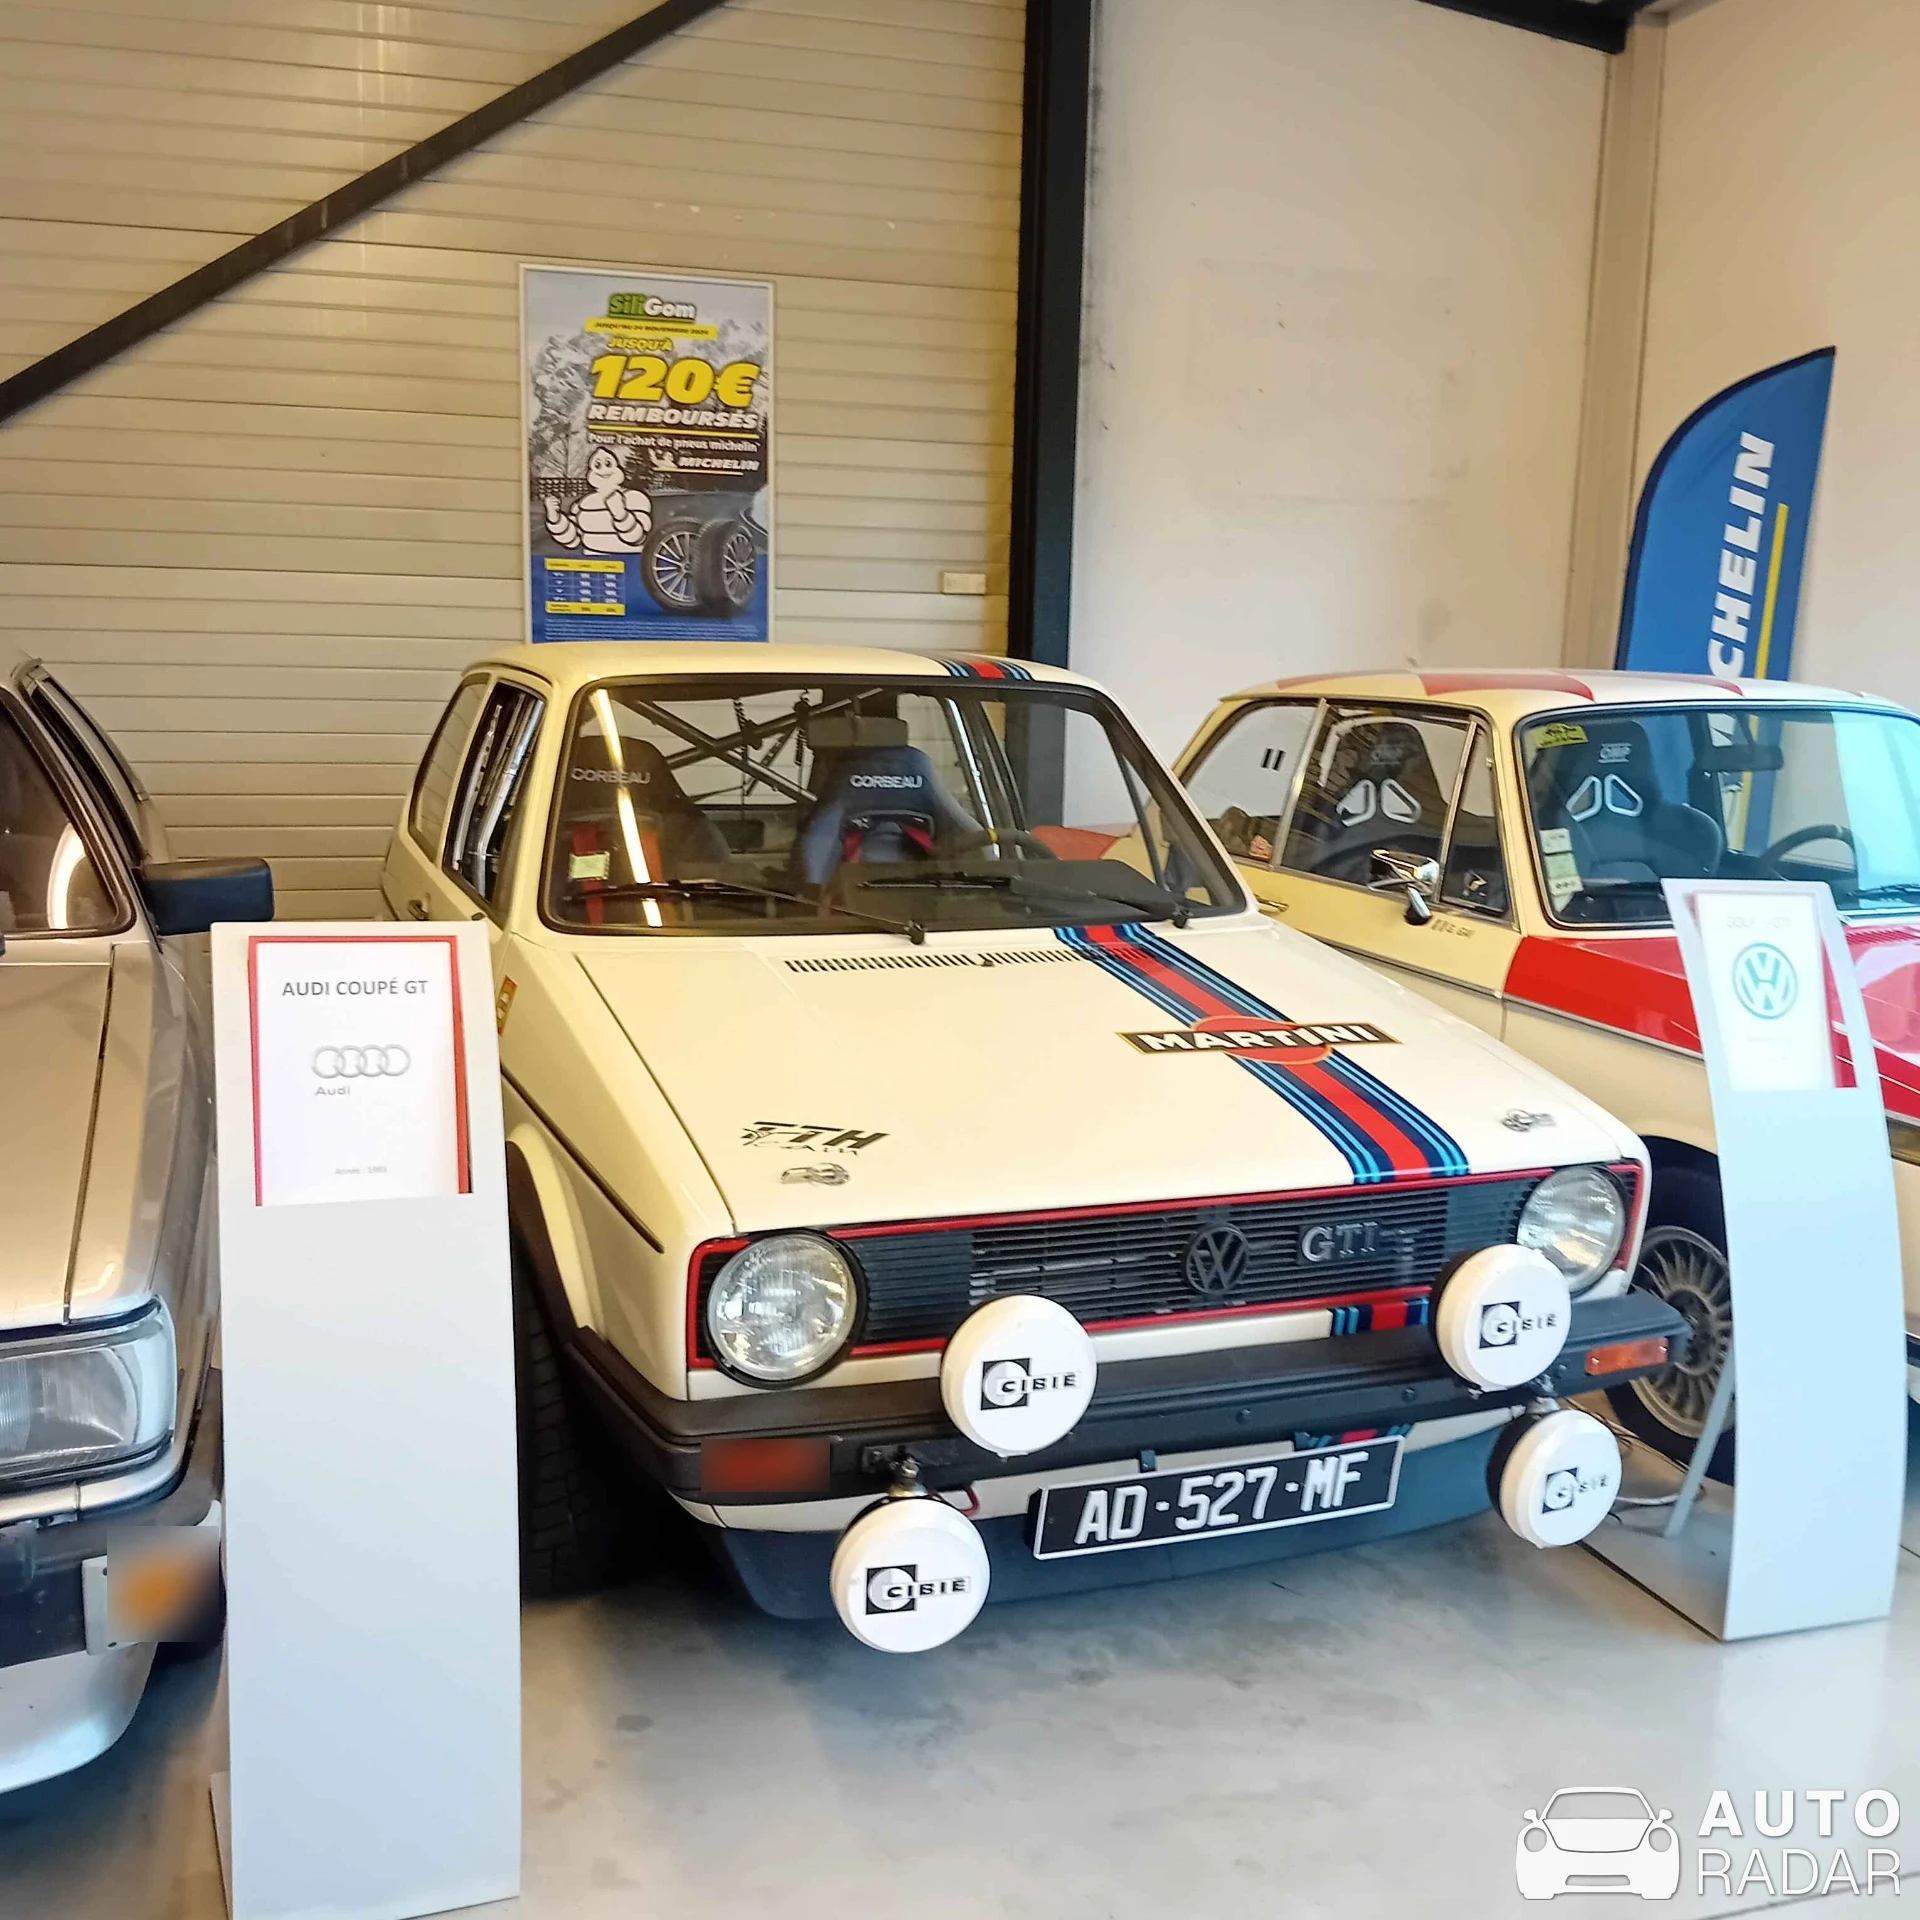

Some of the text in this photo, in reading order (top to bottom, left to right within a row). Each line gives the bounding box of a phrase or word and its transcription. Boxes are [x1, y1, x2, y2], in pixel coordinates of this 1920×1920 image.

[609, 293, 696, 319] SiliGom
[591, 353, 760, 408] 120€
[657, 437, 672, 448] de
[673, 439, 709, 451] pneus
[678, 456, 760, 471] MICHELIN
[570, 768, 651, 784] CORBEAU
[849, 775, 923, 789] CORBEAU
[281, 977, 428, 996] AUDI COUPÉ GT
[1136, 1024, 1380, 1051] MARTINI
[315, 1085, 351, 1096] Audi
[1301, 1221, 1379, 1262] GTI
